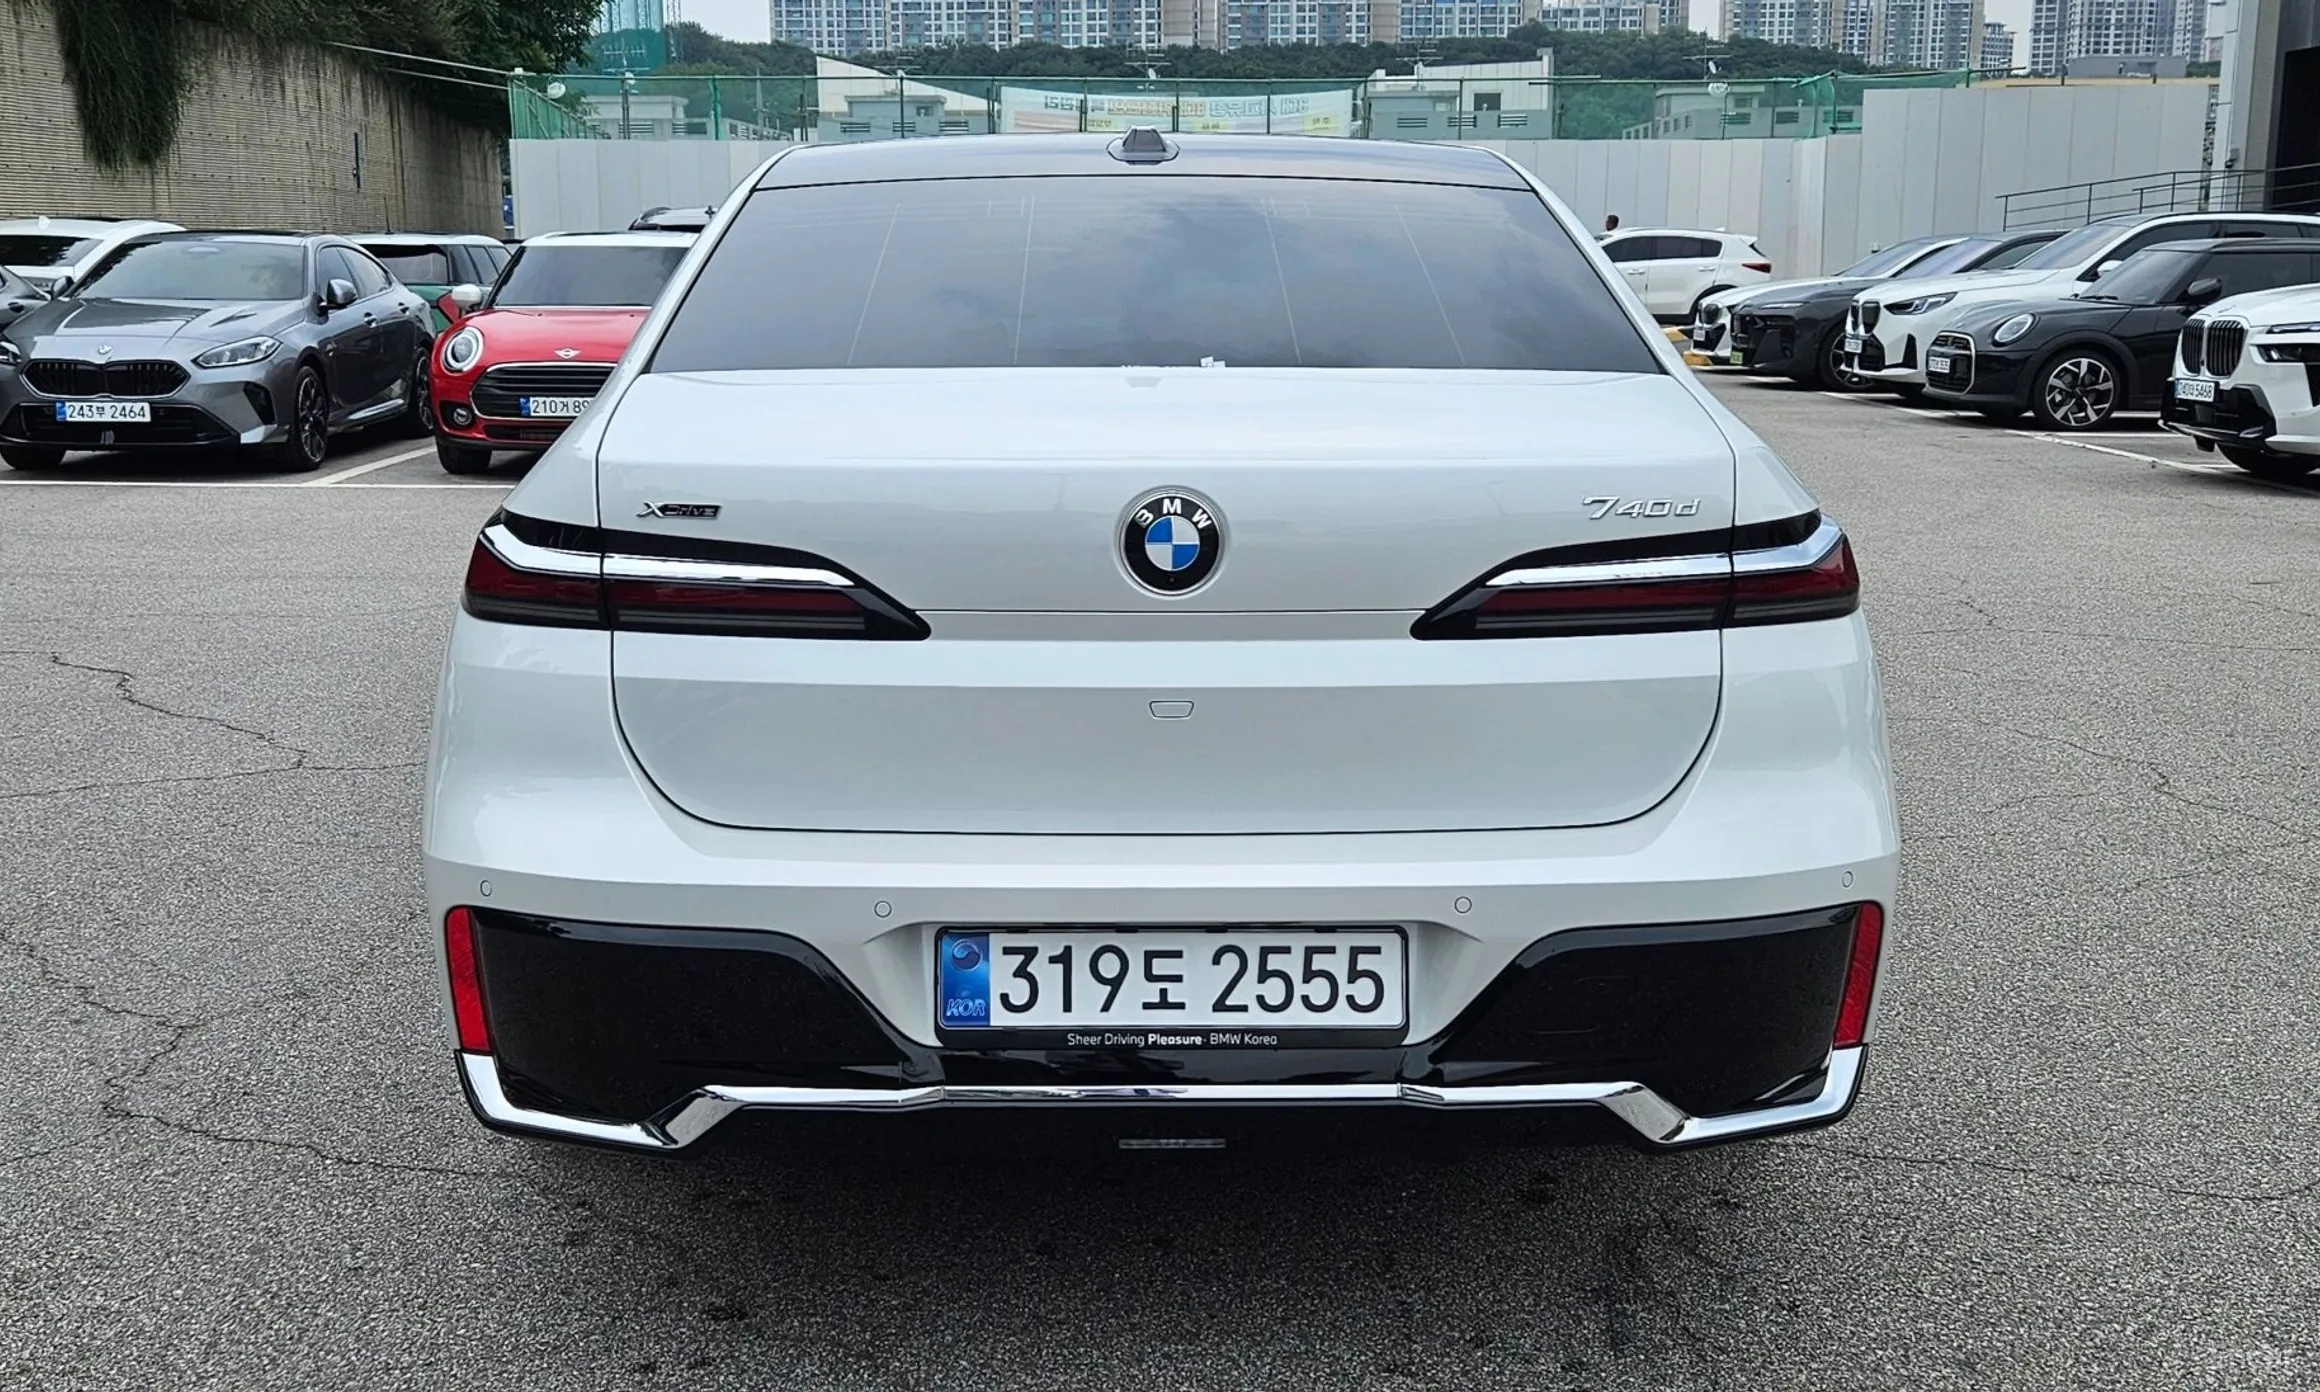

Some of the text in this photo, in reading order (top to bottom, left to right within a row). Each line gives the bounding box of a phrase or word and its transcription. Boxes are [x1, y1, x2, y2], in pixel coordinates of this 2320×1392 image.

[67, 404, 146, 418] 243부 2464
[532, 399, 569, 413] 210거
[1134, 498, 1212, 528] BMW
[1582, 496, 1701, 520] 740d
[999, 944, 1385, 1014] 319도 2555
[945, 998, 987, 1017] KOR
[1067, 1033, 1101, 1045] Sheer
[1104, 1033, 1145, 1047] Driving
[1209, 1033, 1242, 1045] BMW
[1244, 1033, 1278, 1045] Korea
